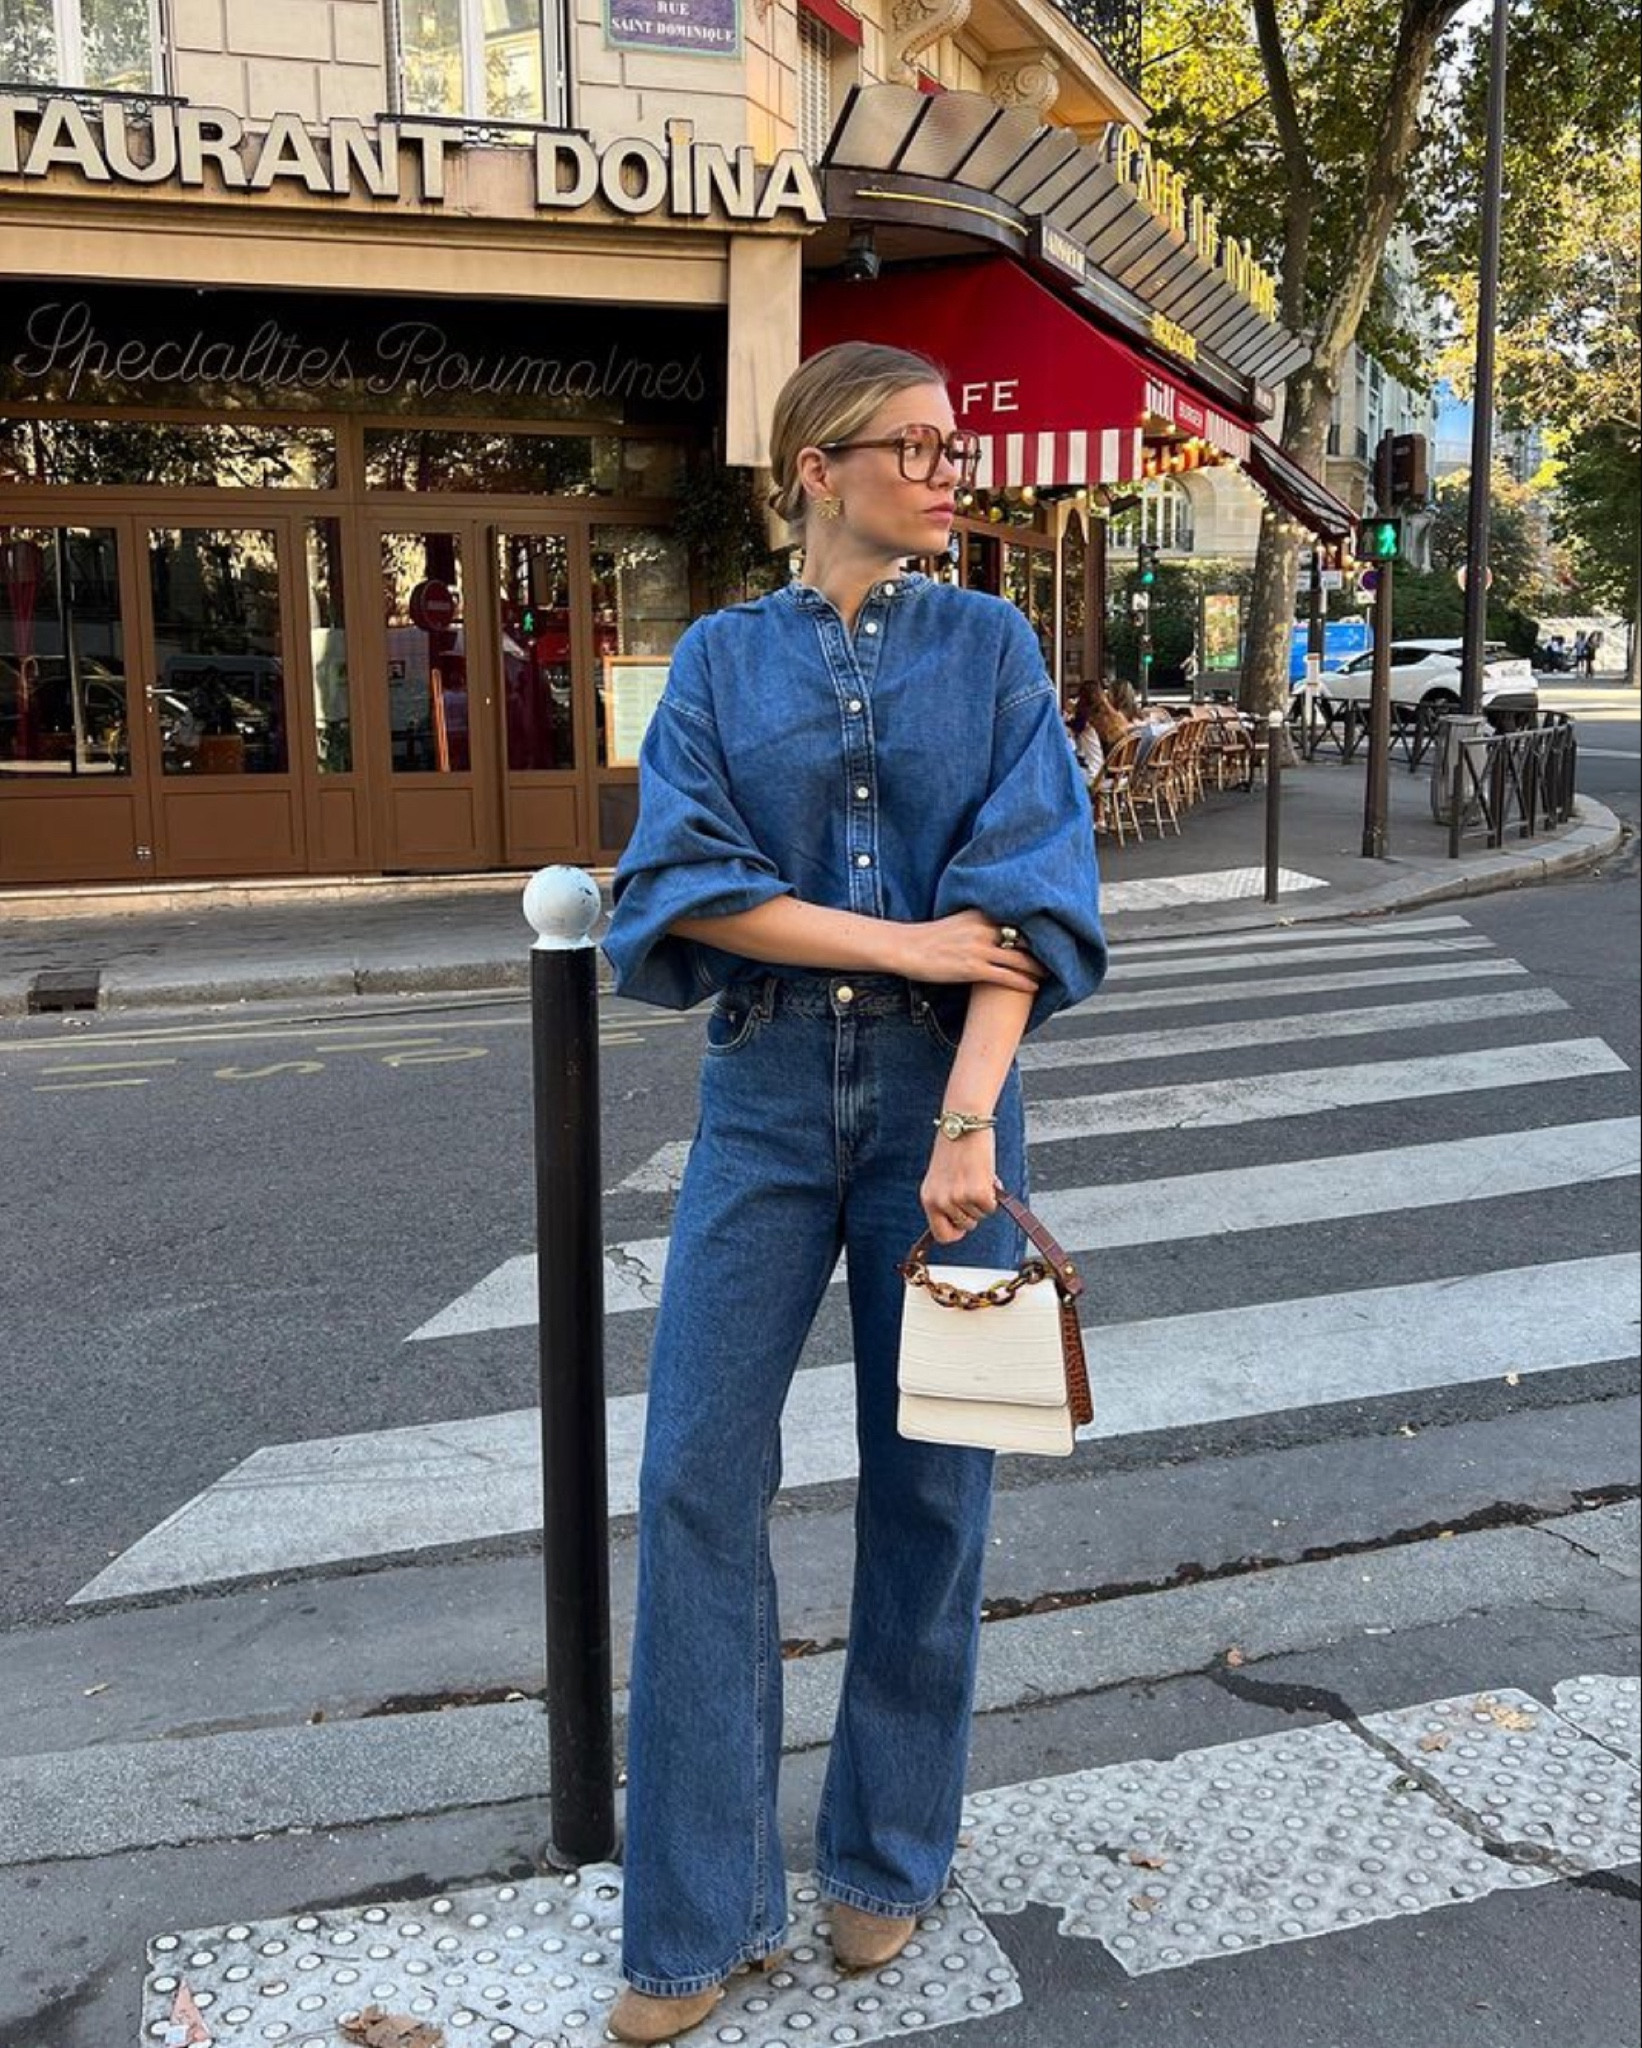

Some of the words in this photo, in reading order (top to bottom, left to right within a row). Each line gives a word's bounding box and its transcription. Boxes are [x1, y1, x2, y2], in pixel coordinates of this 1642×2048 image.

[657, 1, 690, 16] RUE
[611, 18, 652, 34] SAINT
[656, 22, 735, 42] DOMINIQUE
